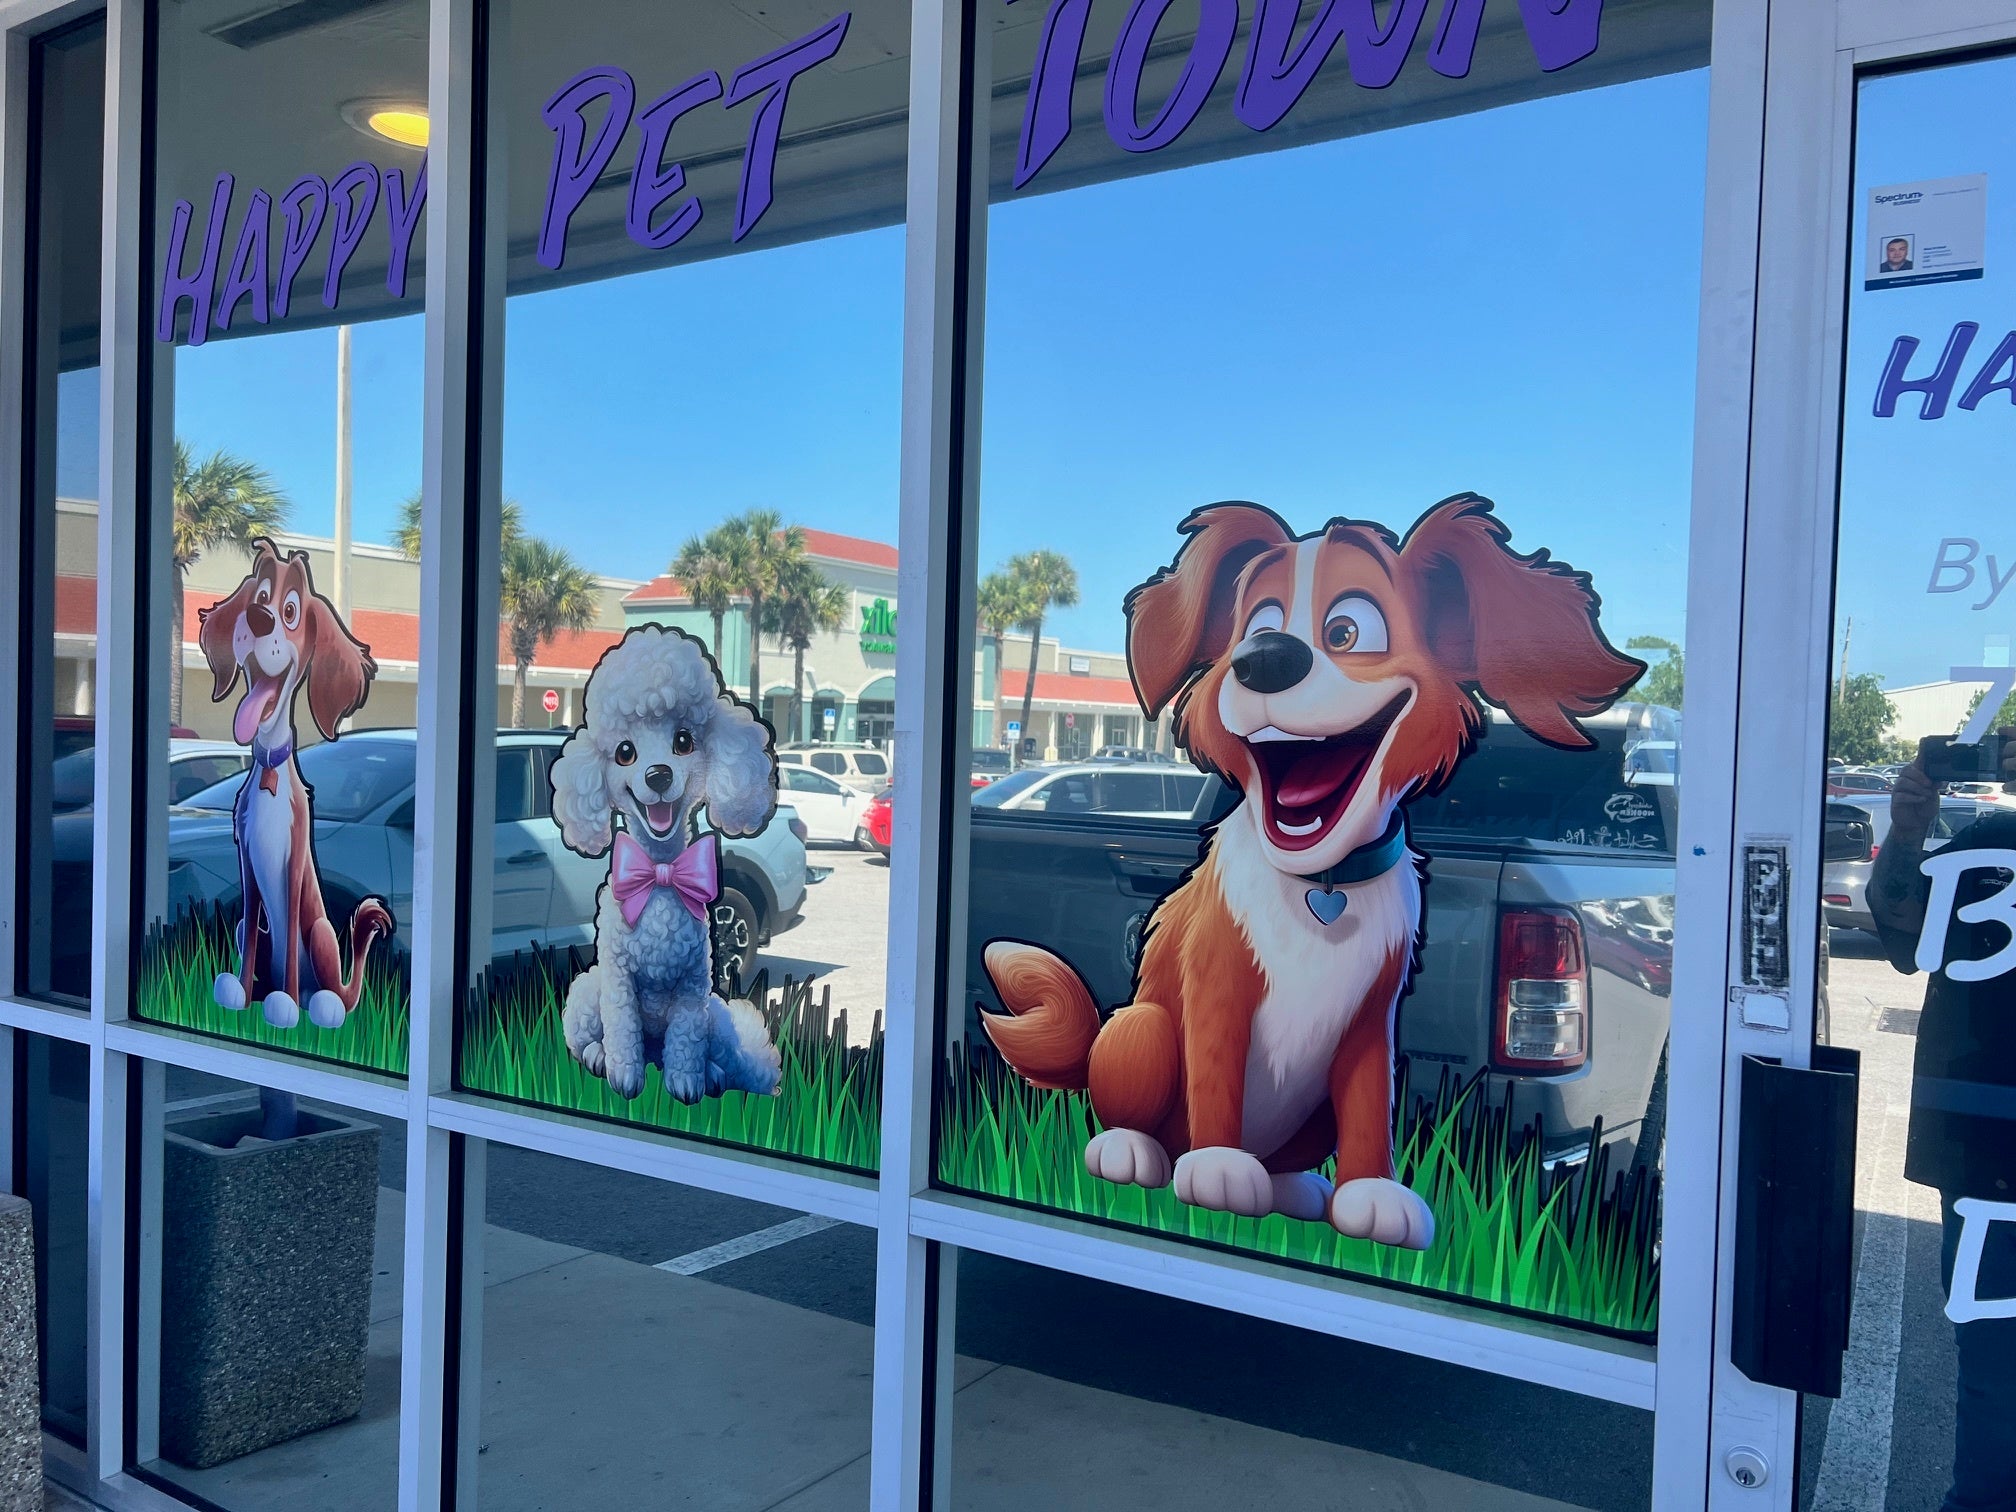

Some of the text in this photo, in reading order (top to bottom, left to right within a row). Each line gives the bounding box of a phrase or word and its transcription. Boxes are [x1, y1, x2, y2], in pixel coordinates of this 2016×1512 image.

[157, 150, 428, 346] HAPPY
[536, 12, 851, 271] PET
[1874, 191, 1921, 205] Spectrum
[1926, 537, 2016, 611] By
